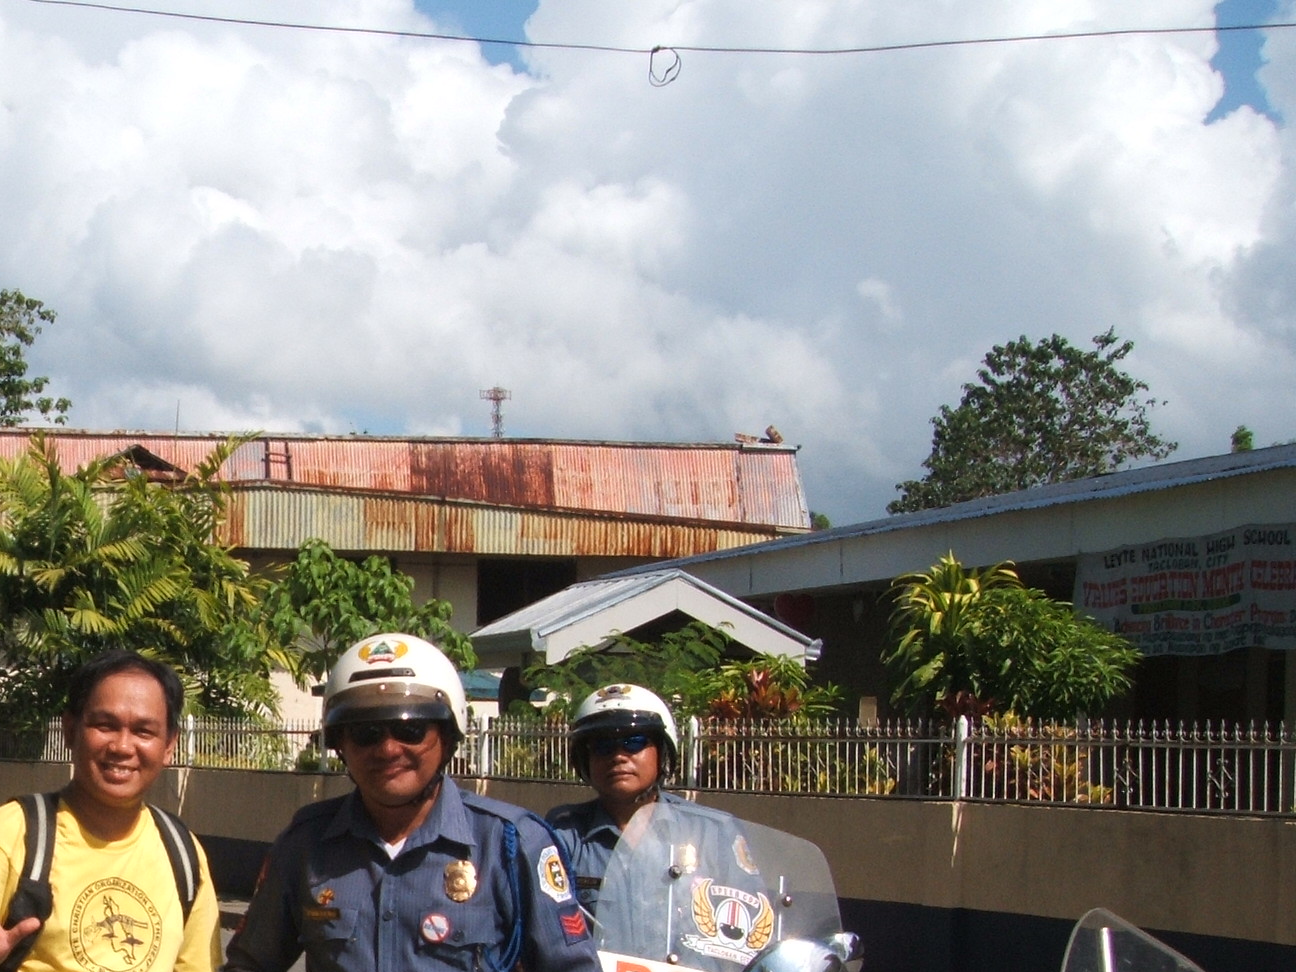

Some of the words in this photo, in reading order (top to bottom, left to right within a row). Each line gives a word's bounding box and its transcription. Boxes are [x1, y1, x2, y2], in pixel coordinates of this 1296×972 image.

[1104, 549, 1136, 569] LEYTE
[1142, 543, 1198, 561] NATIONAL
[1206, 535, 1235, 555] HIGH
[1243, 529, 1291, 545] SCHOOL
[1206, 553, 1228, 568] CITY
[73, 888, 94, 933] CHRISTIAN
